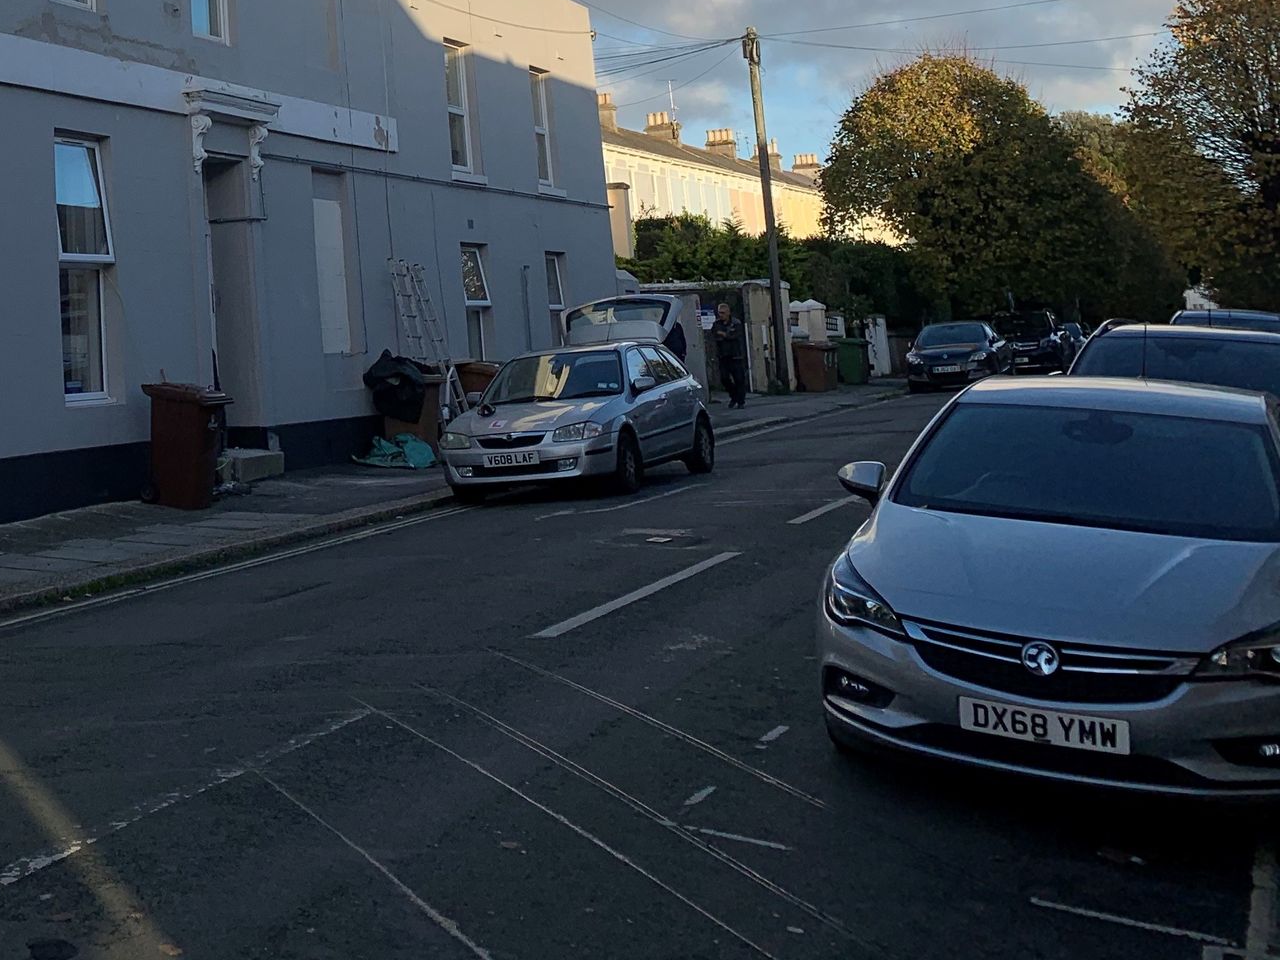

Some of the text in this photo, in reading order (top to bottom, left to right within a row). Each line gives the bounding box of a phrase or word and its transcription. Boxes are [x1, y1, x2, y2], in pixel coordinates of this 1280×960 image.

[487, 452, 534, 466] V608 LAF
[973, 703, 1117, 748] DX68 YMW
